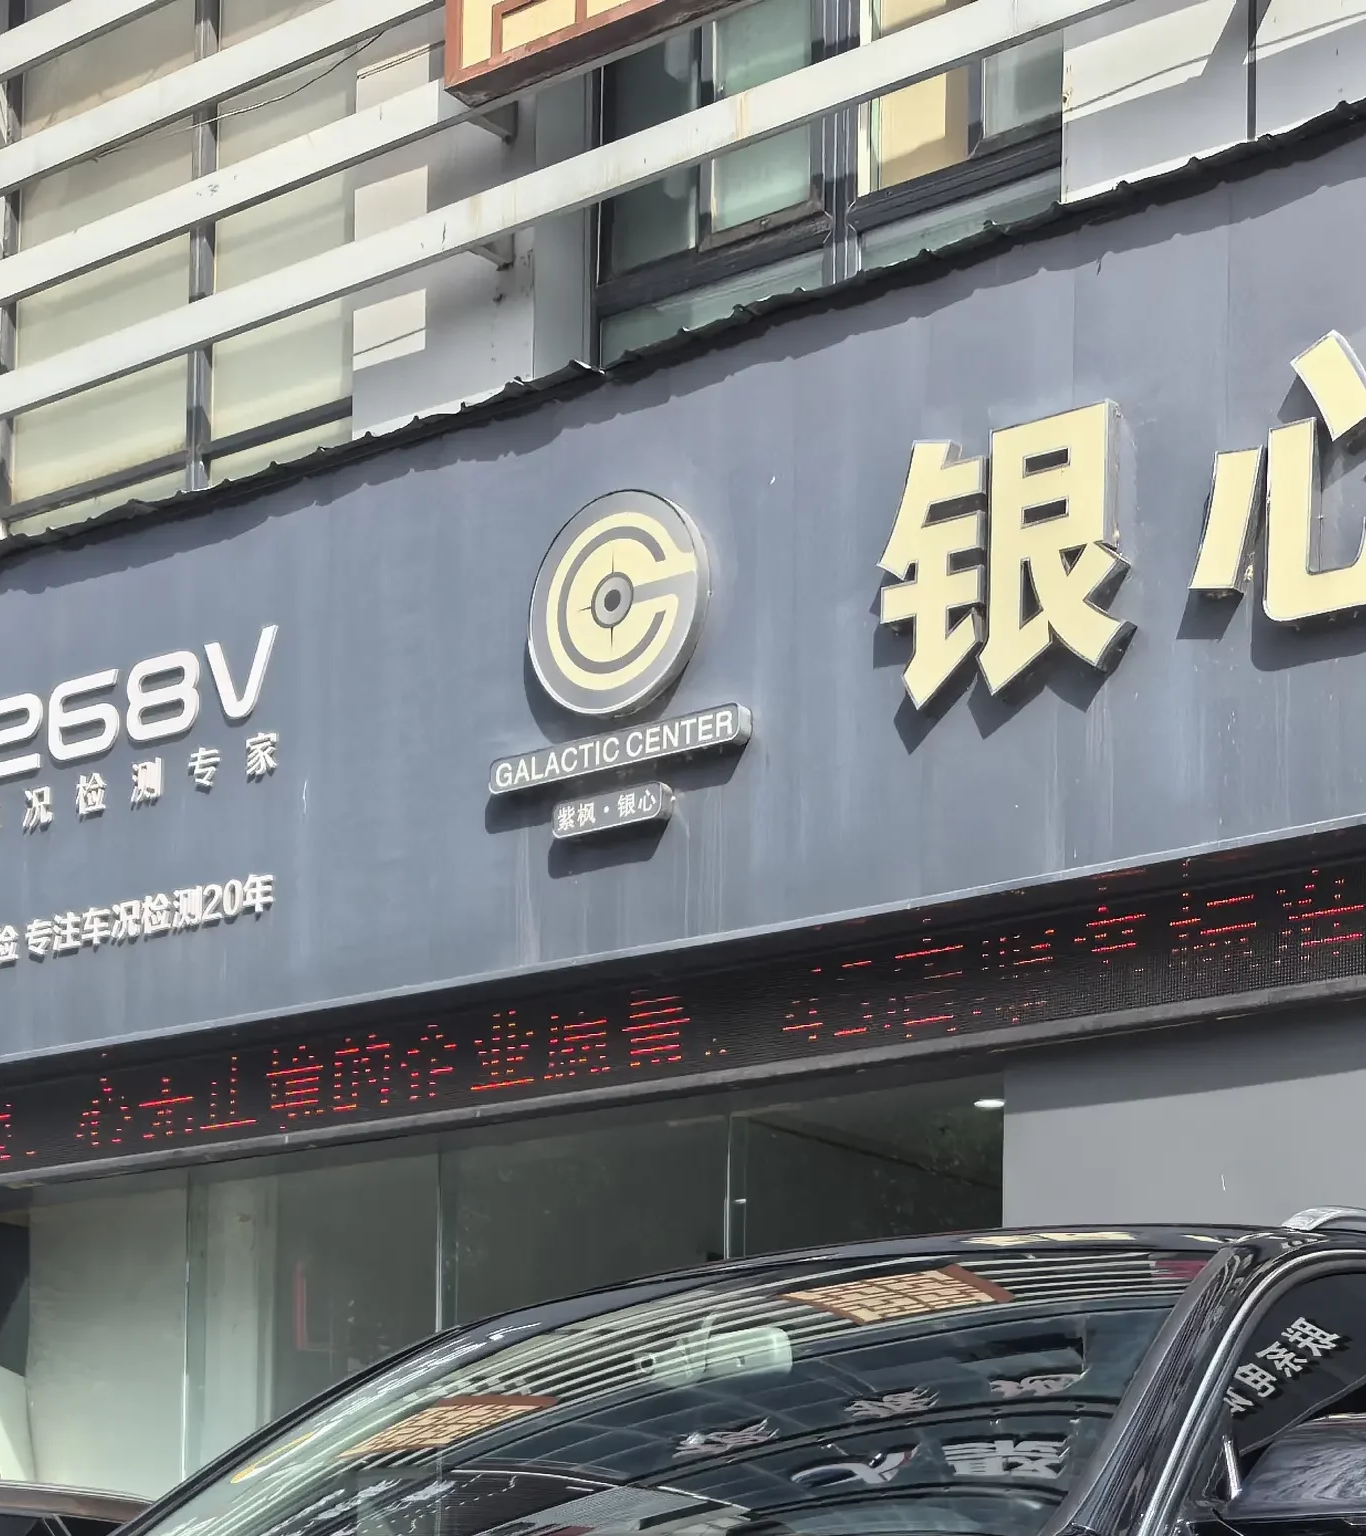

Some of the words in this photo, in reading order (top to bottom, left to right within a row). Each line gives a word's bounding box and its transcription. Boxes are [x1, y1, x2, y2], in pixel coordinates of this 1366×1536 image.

[494, 736, 621, 788] GALACTIC
[625, 710, 734, 760] CENTER
[25, 874, 275, 955] 专注车况检测20年
